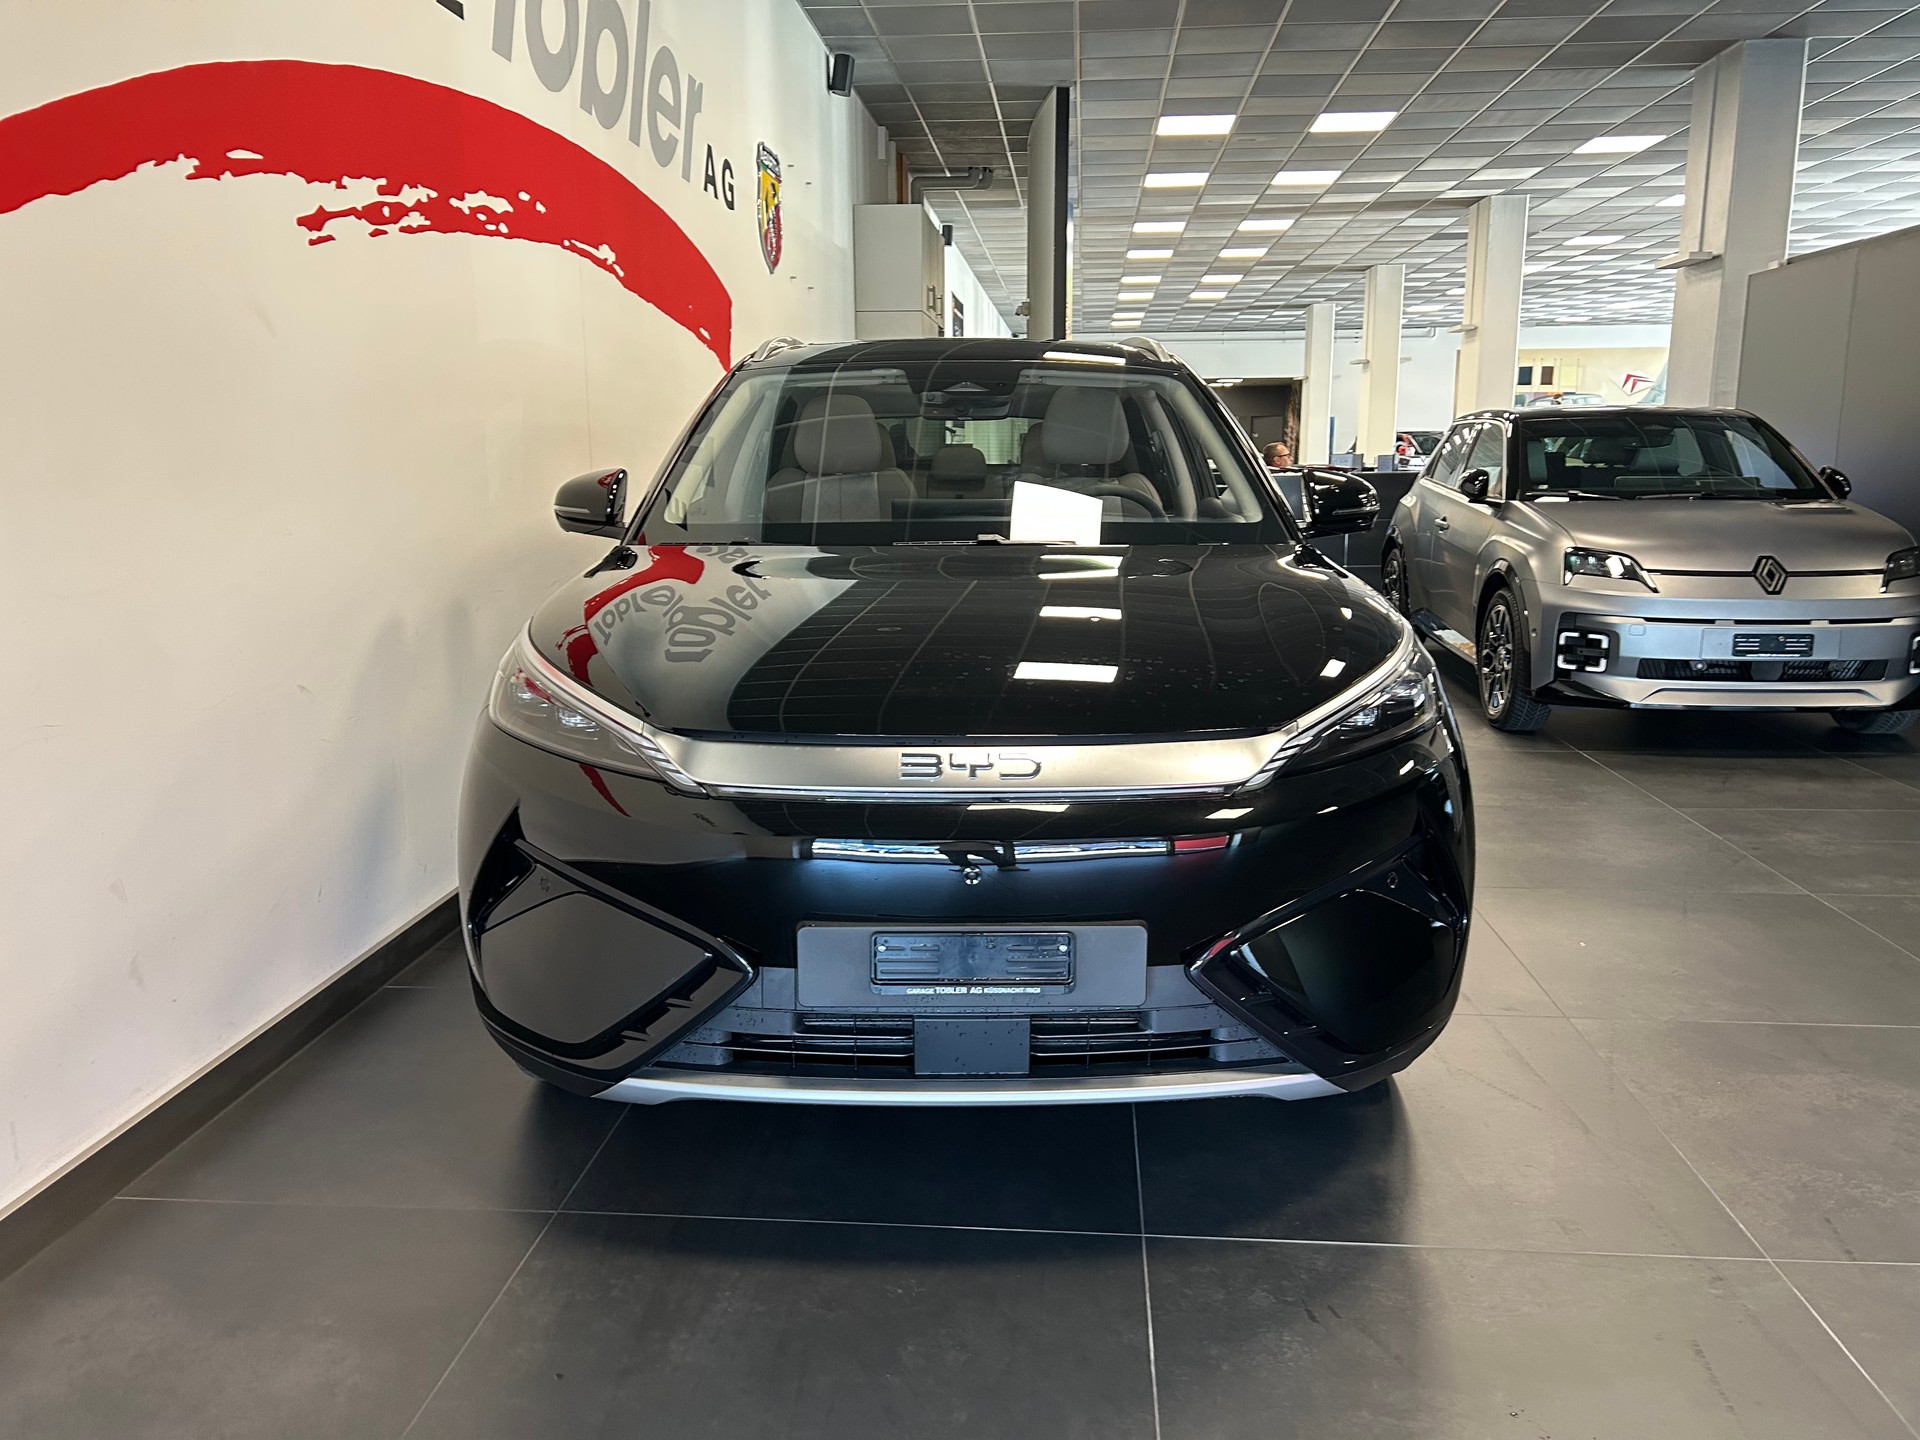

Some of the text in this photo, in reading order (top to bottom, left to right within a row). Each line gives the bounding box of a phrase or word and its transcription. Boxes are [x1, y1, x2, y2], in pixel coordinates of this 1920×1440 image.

[704, 143, 735, 210] AG
[900, 753, 1042, 781] BYD
[935, 986, 967, 994] TOBLER
[970, 986, 982, 994] AG
